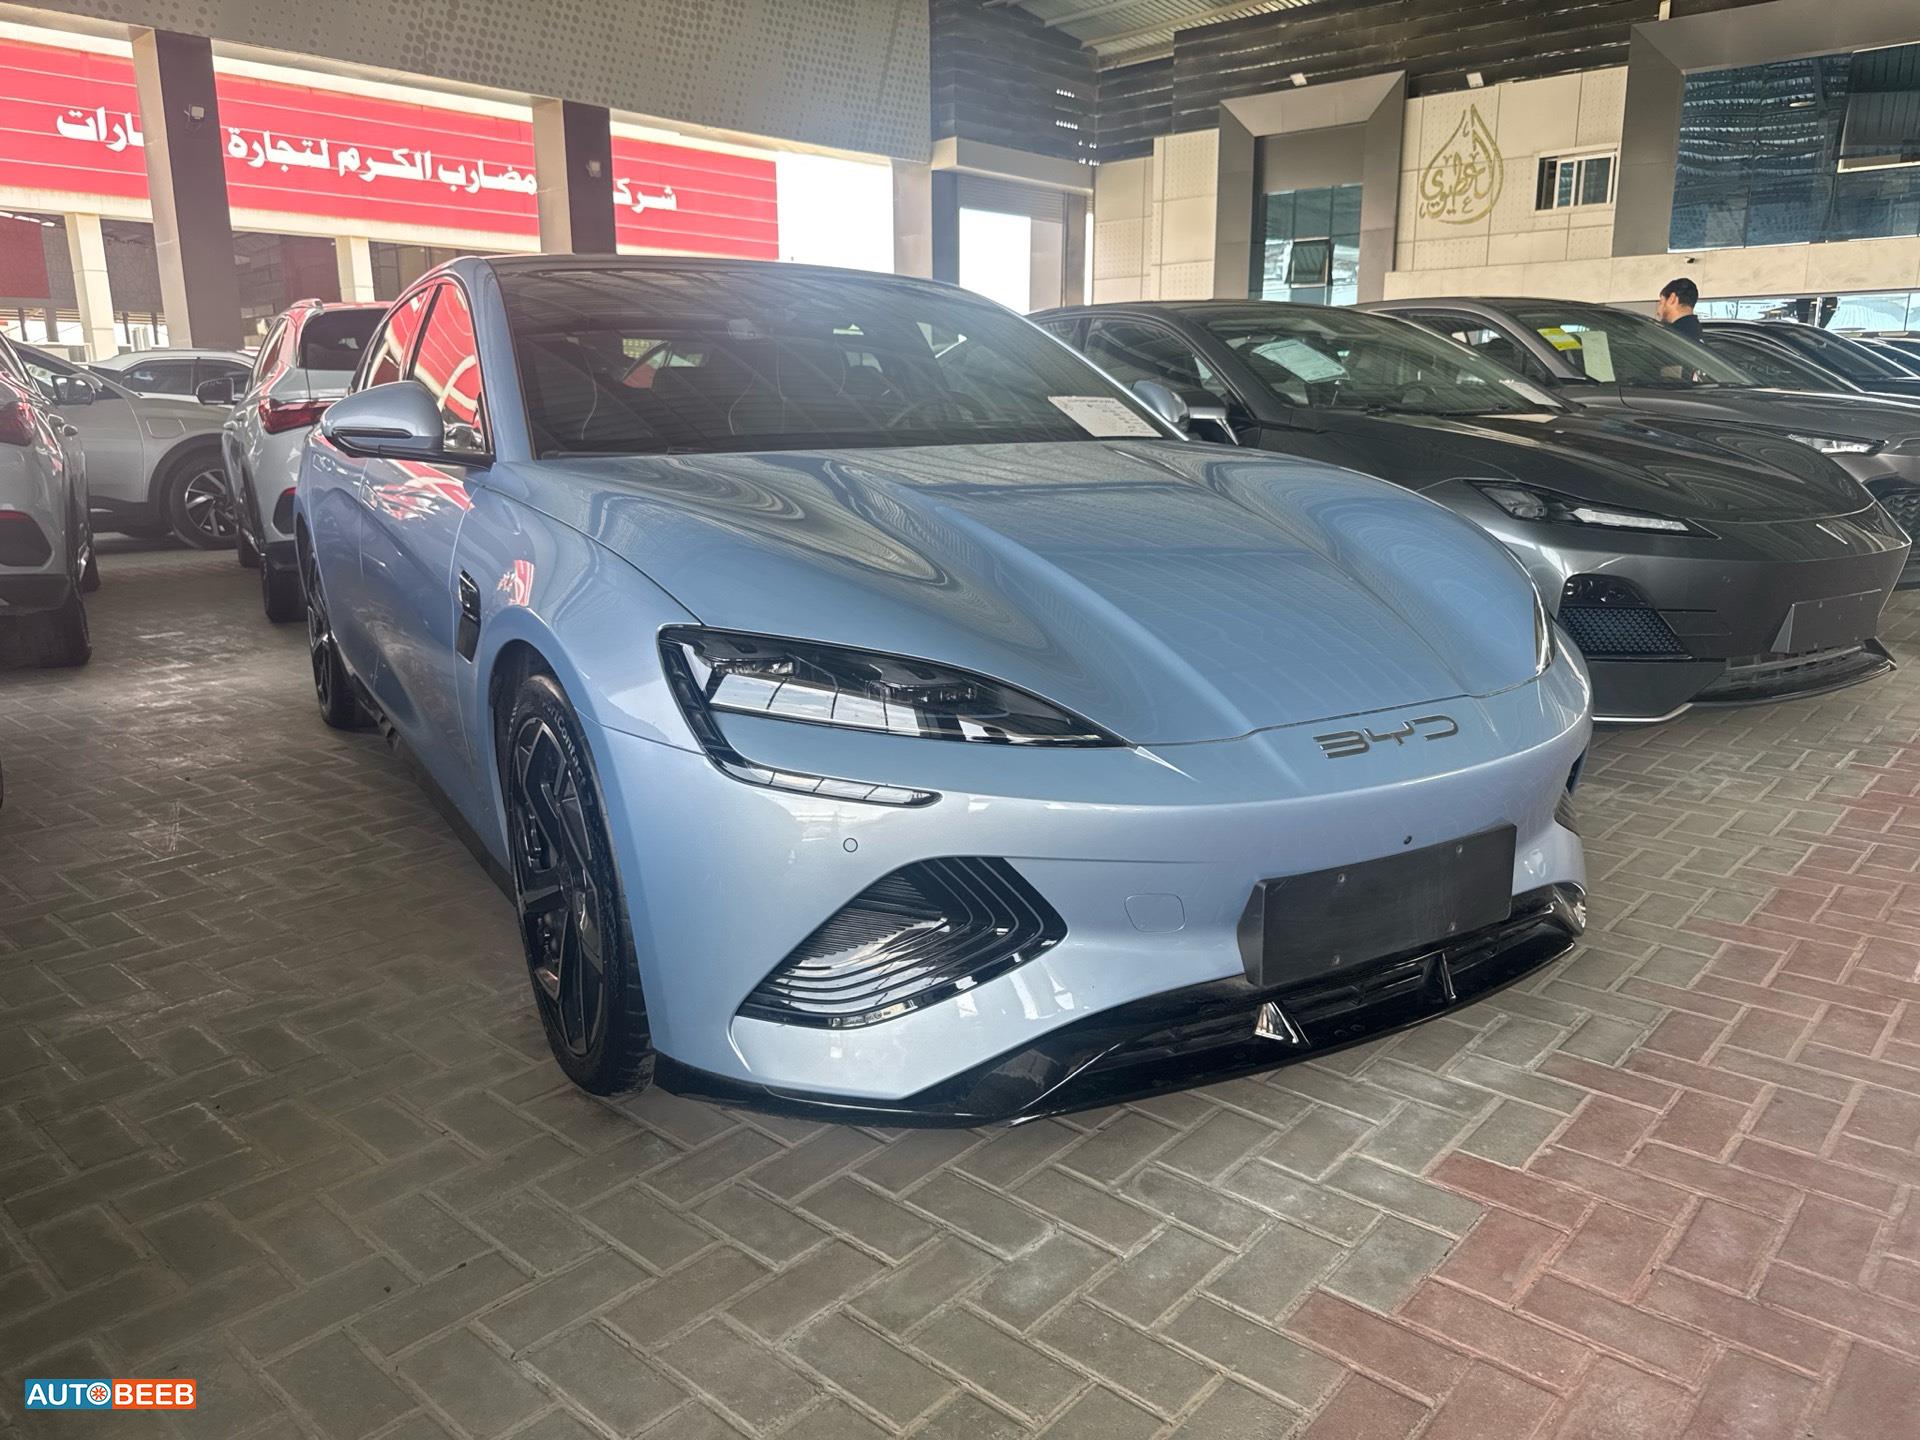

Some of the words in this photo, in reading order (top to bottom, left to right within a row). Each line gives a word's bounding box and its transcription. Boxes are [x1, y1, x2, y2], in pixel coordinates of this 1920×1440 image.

[56, 106, 145, 152] ارات
[227, 127, 331, 172] لتجارة
[338, 147, 432, 183] الكرم
[438, 160, 538, 195] مضارب
[613, 177, 678, 214] شرك
[1312, 714, 1459, 759] BYD
